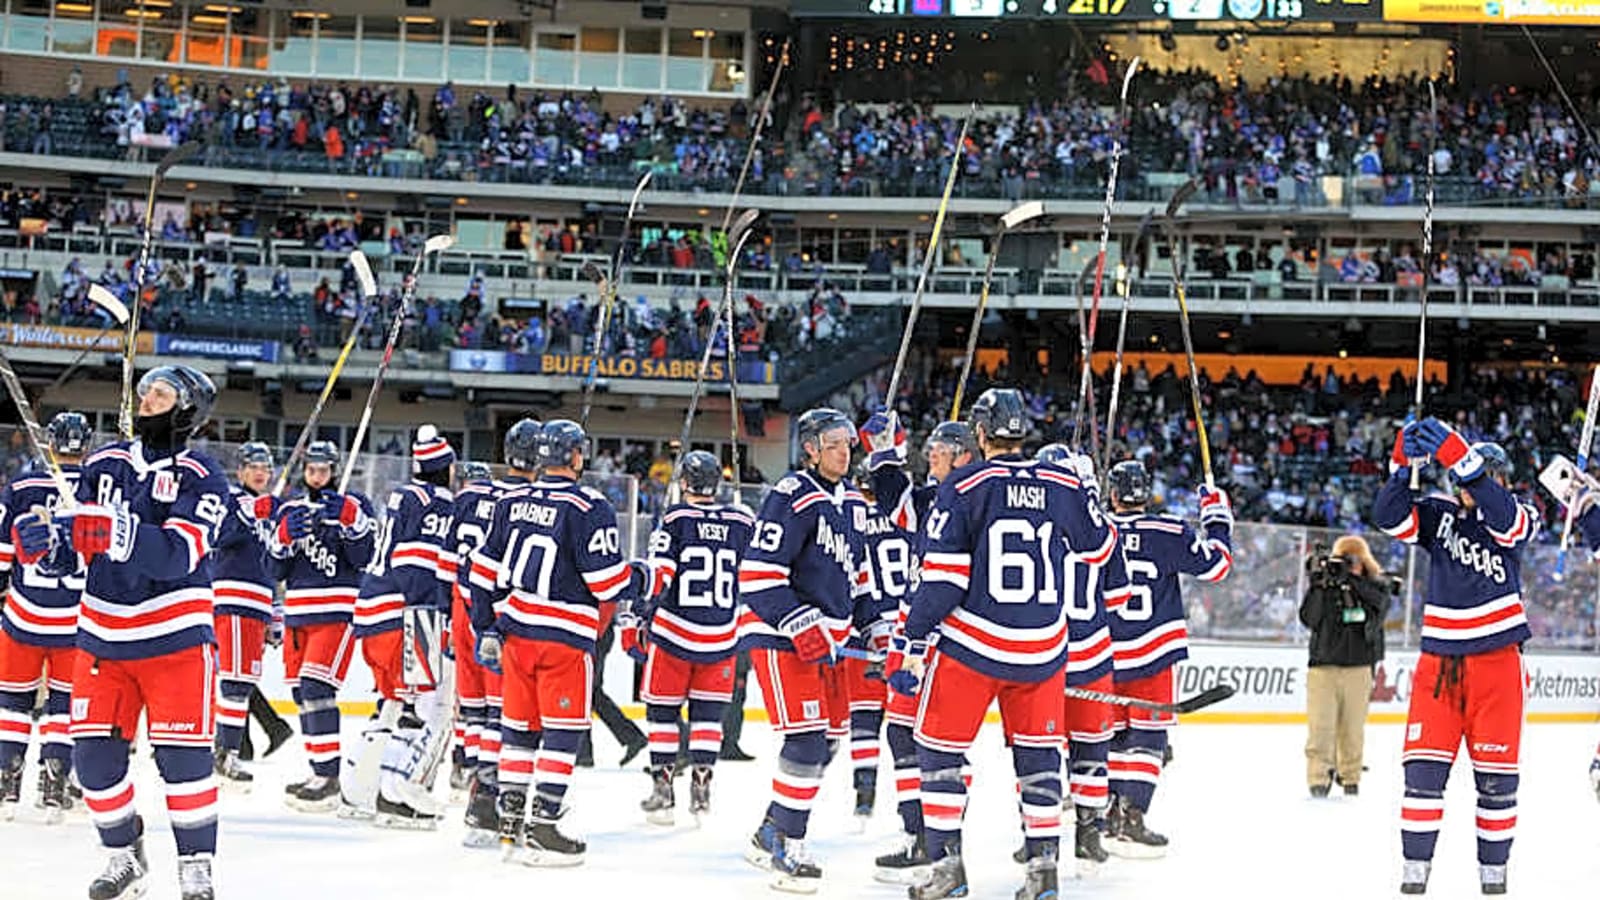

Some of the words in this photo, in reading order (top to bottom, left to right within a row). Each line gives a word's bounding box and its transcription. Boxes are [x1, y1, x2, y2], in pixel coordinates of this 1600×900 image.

[541, 354, 636, 377] BUFFALO
[1007, 484, 1045, 510] NASH
[588, 527, 620, 556] 40
[750, 520, 783, 551] 13
[988, 519, 1058, 604] 61
[678, 546, 737, 609] 26
[1063, 549, 1099, 620] 0
[1117, 559, 1159, 621] 6
[1176, 664, 1298, 695] IDGESTONE
